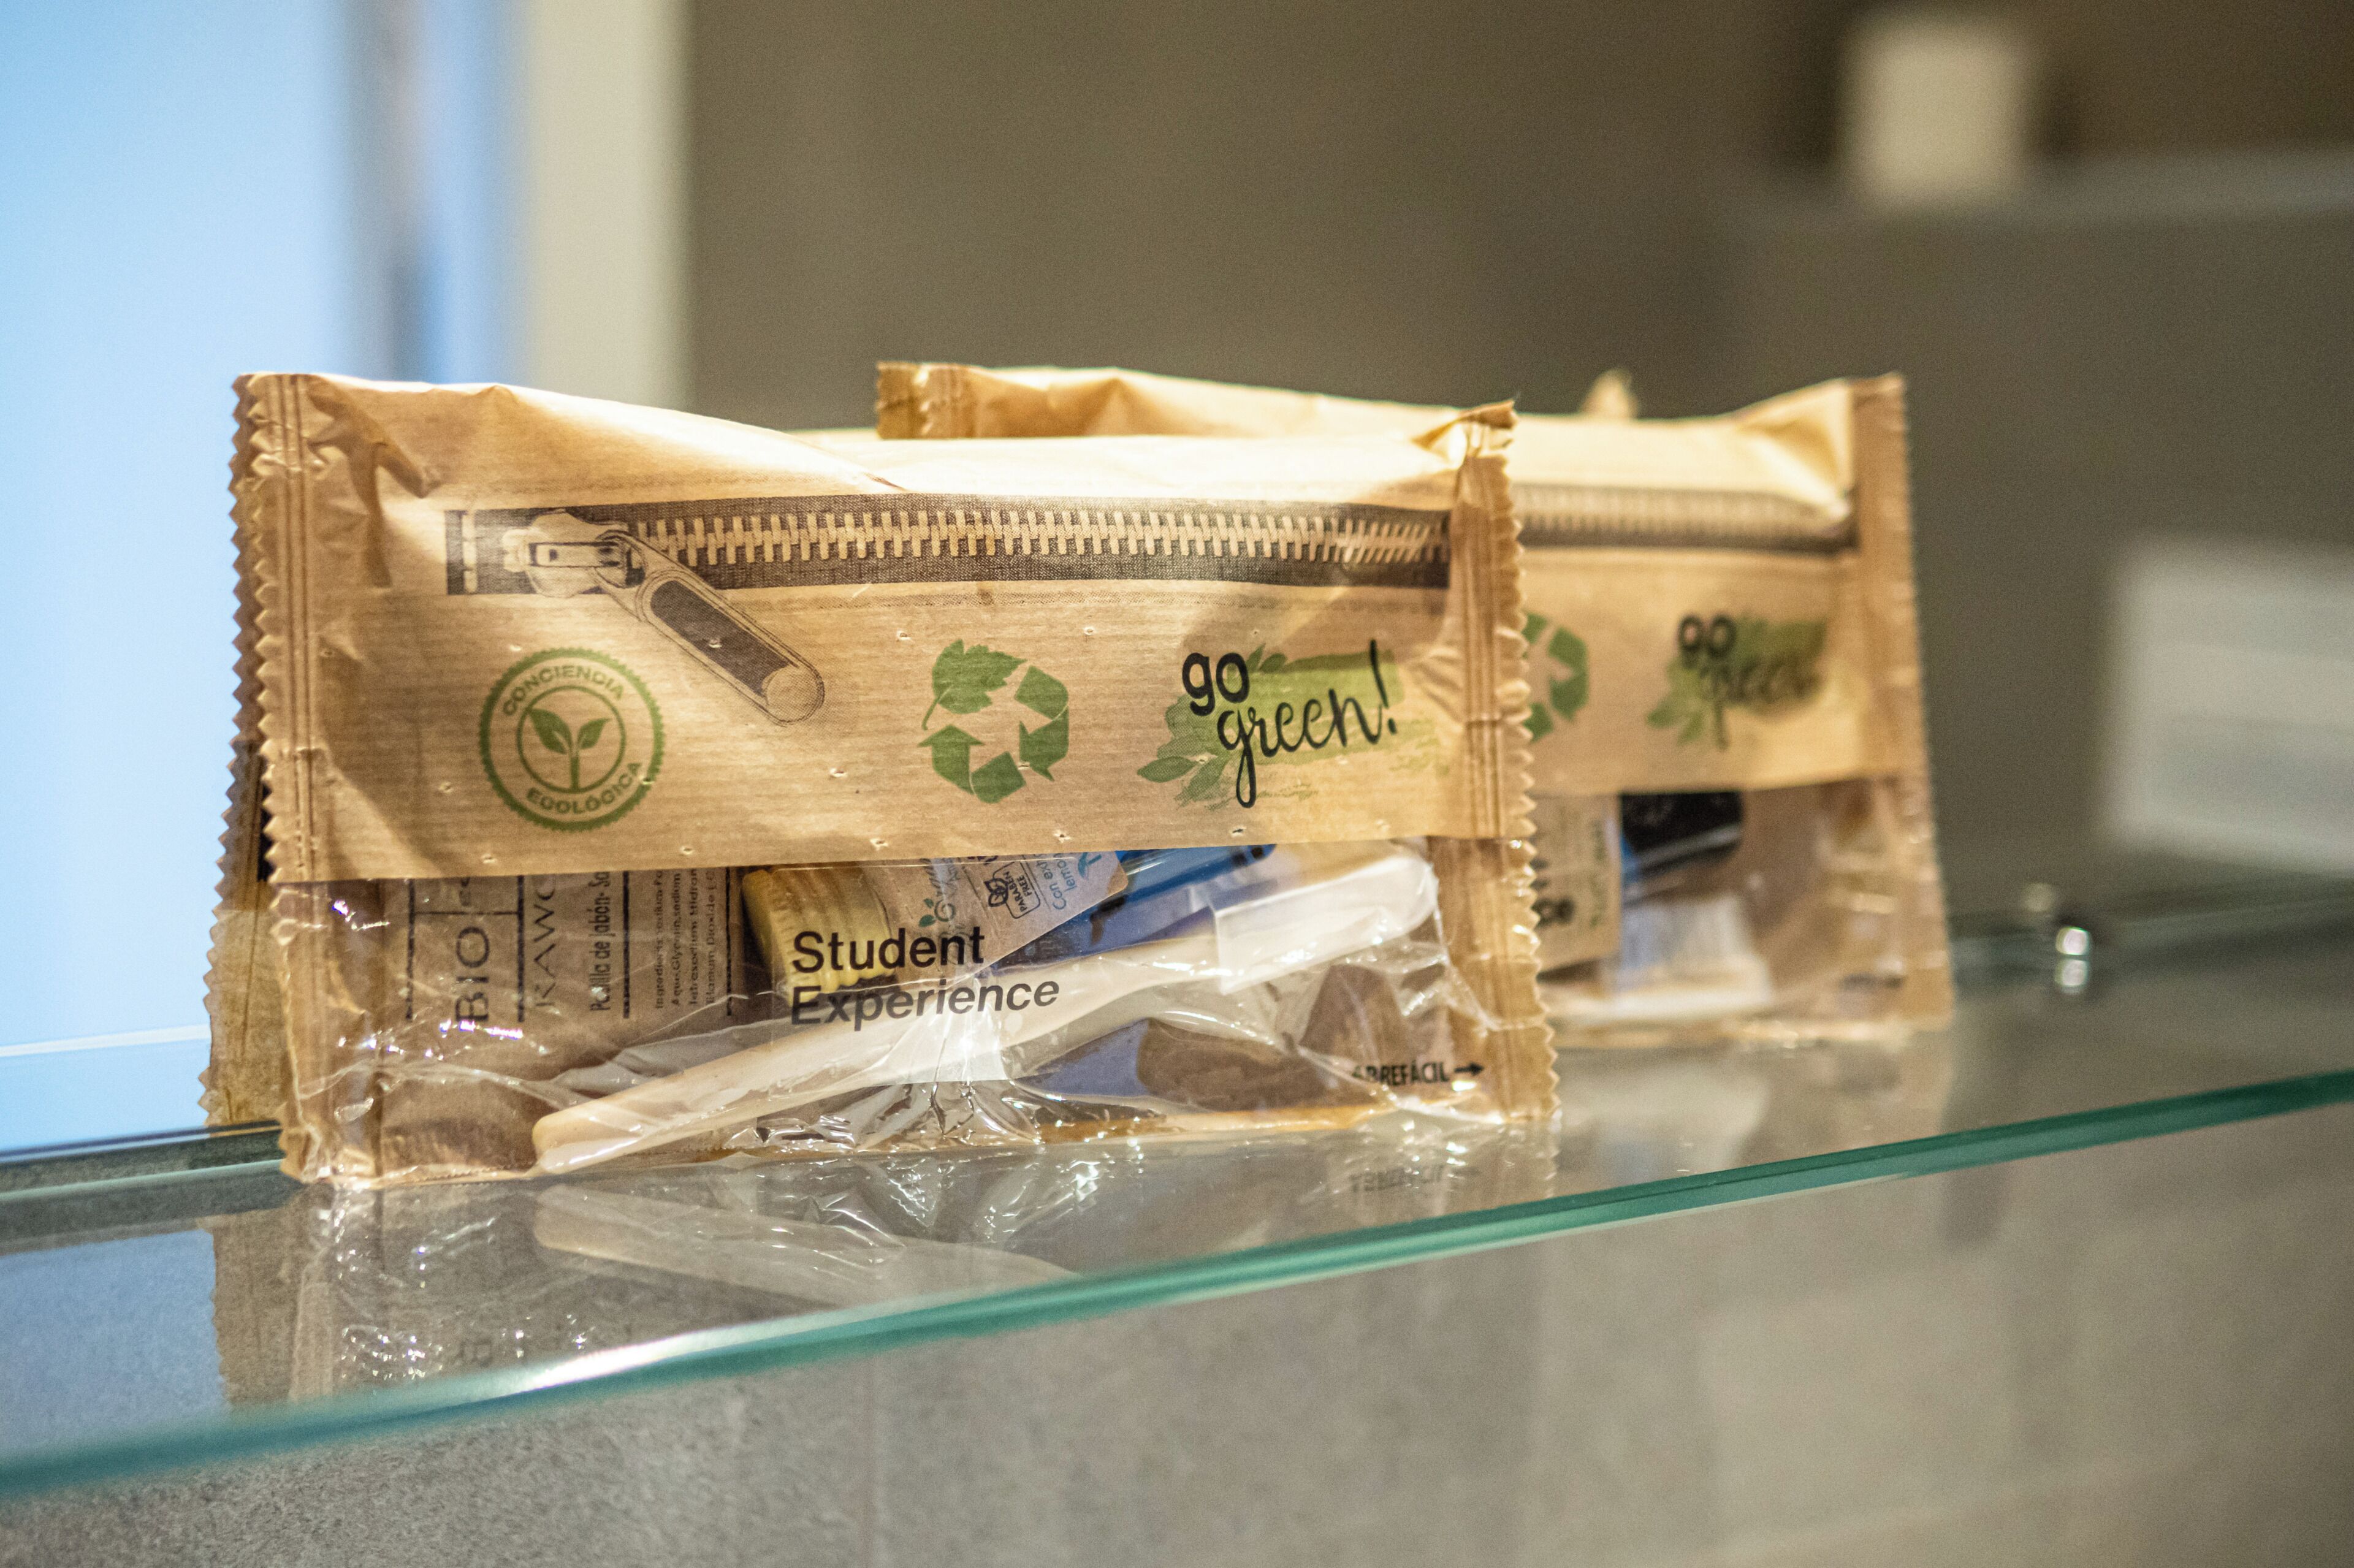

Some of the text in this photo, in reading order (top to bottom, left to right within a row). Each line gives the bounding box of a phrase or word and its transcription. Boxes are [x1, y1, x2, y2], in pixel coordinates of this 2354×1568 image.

[503, 664, 625, 716] CONCIENCIA
[1182, 652, 1250, 716] go
[1217, 639, 1398, 809] green!
[1003, 871, 1027, 912] PARABEN
[1016, 875, 1032, 897] FREE
[1049, 881, 1067, 910] Con
[455, 926, 490, 1022] BIO
[588, 942, 611, 959] de
[791, 926, 985, 973] Student
[790, 978, 1060, 1032] Experience
